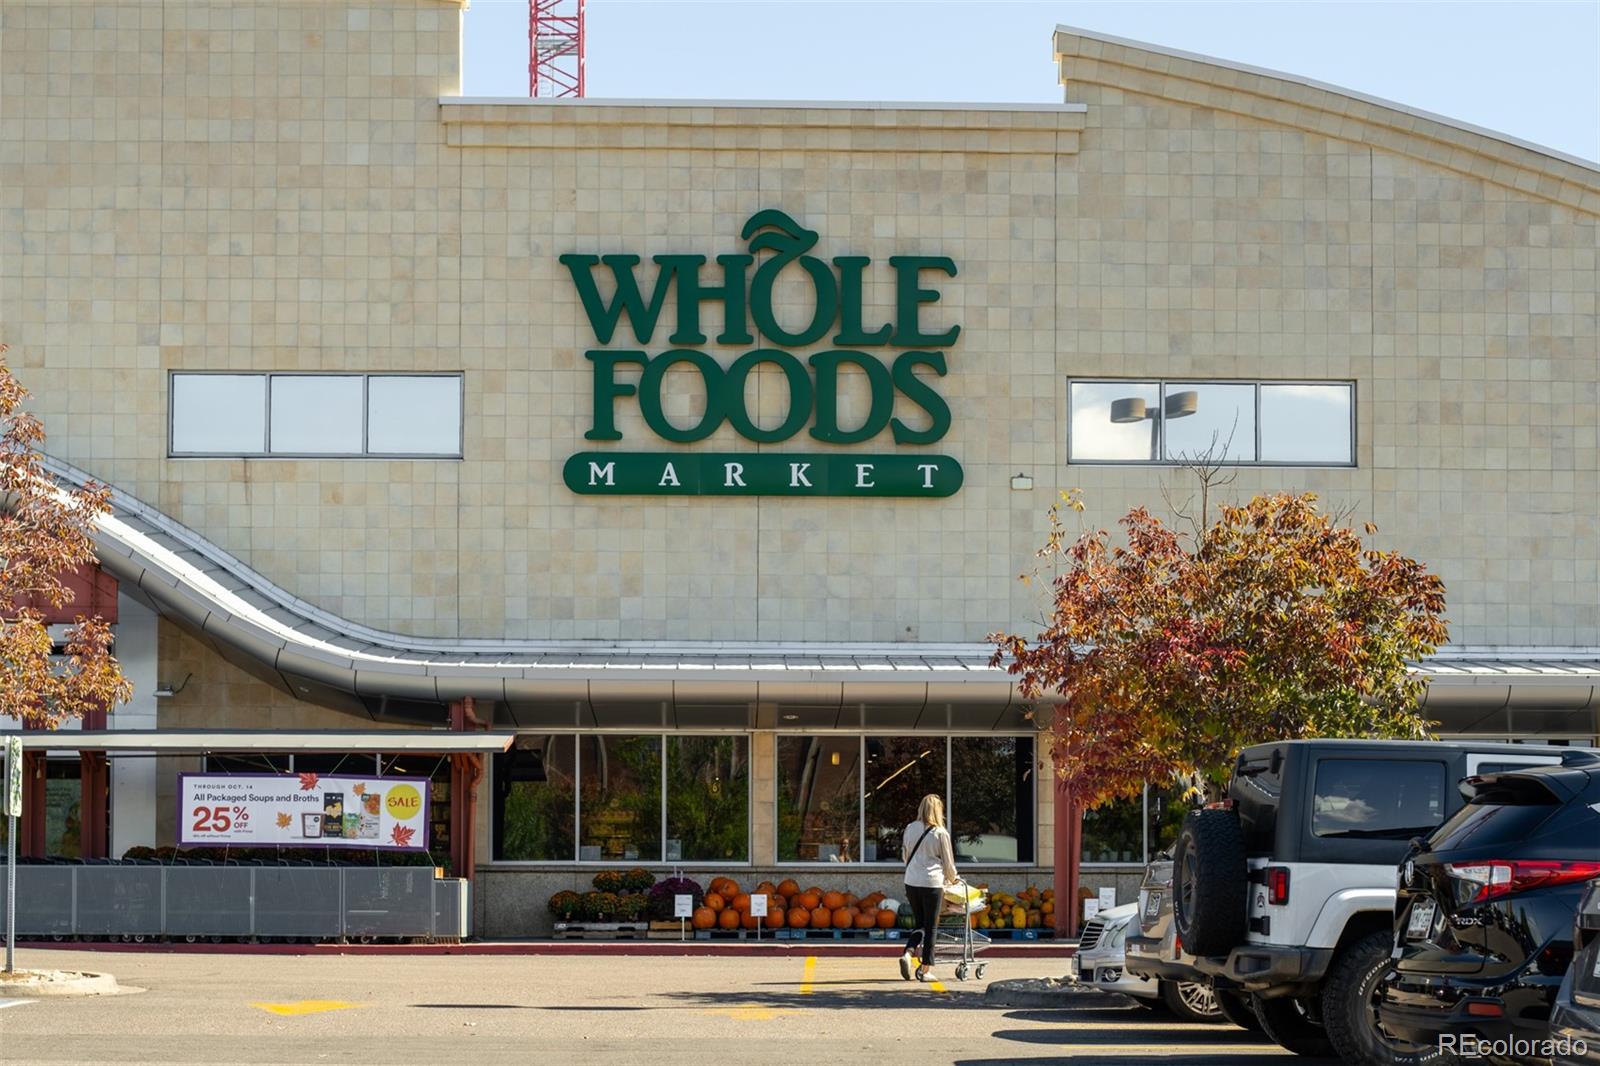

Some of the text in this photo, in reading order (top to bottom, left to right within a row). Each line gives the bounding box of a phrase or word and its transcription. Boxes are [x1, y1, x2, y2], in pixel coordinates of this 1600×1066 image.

[559, 240, 961, 346] WHOLE
[584, 349, 952, 444] FOODS
[588, 462, 939, 488] MARKET
[193, 793, 205, 801] All
[207, 793, 246, 803] Packaged
[248, 793, 274, 803] Soups
[276, 794, 291, 802] and
[293, 794, 319, 802] Broths
[387, 796, 418, 808] SALE
[1456, 917, 1484, 926] RDX
